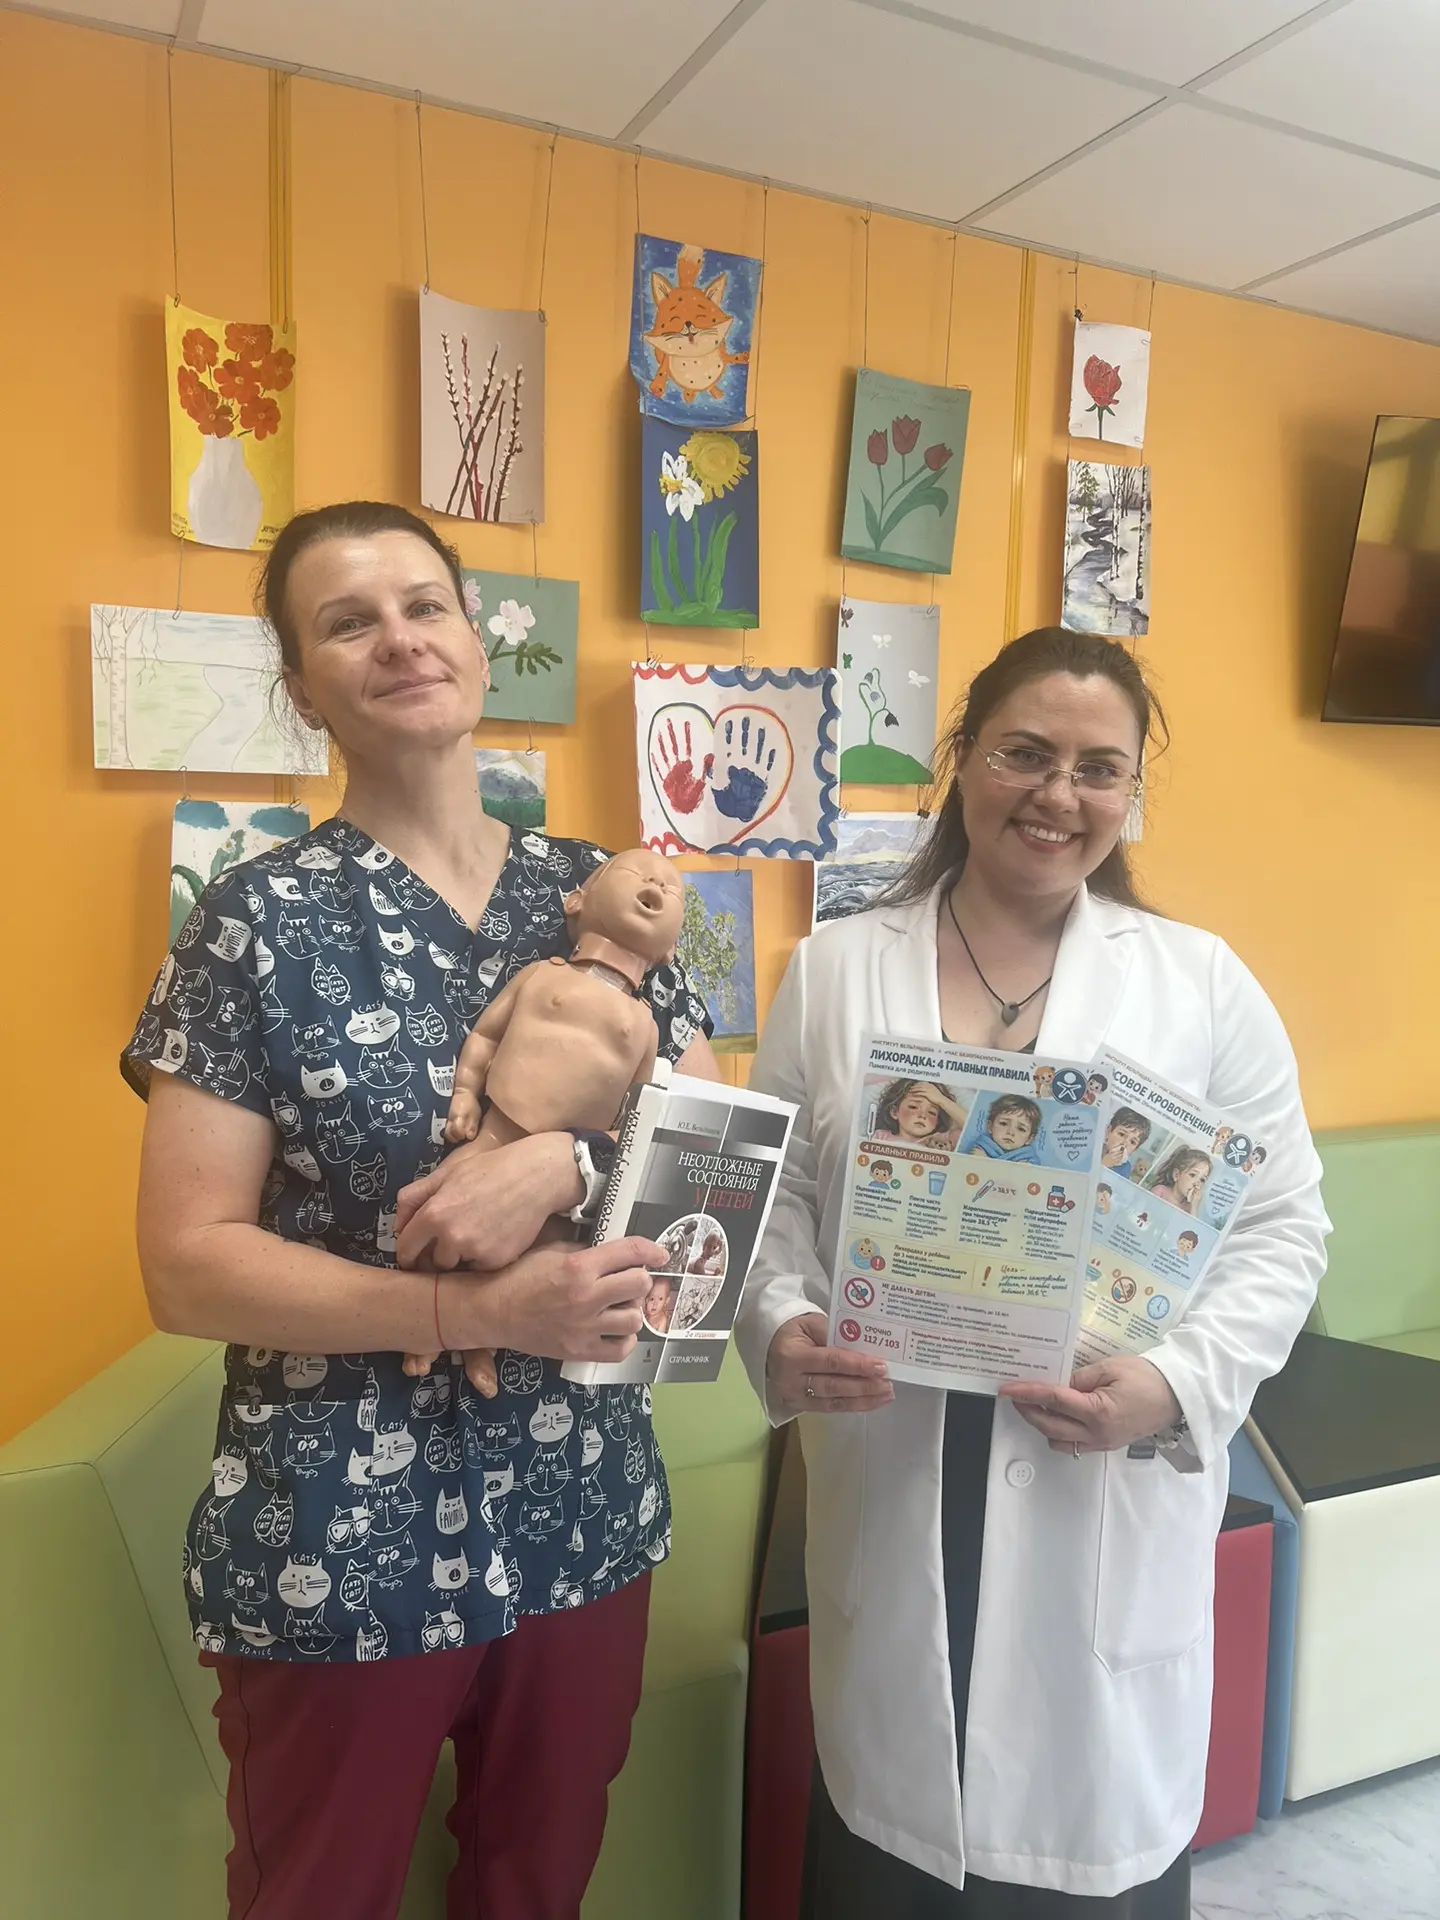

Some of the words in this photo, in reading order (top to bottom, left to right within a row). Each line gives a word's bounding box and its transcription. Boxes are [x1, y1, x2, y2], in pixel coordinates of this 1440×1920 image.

[223, 922, 249, 962] FAVORITE
[357, 1001, 381, 1014] CATS
[869, 1061, 894, 1071] Памятка
[907, 1067, 940, 1078] родителей
[870, 1047, 935, 1069] ЛИХОРАДКА:
[936, 1058, 943, 1068] 4
[945, 1059, 988, 1076] ГЛАВНЫХ
[988, 1065, 1030, 1082] ПРАВИЛА
[1111, 1070, 1149, 1096] СОВОЕ
[1145, 1090, 1217, 1136] КРОВОТЕЧЕНИЕ
[870, 1144, 908, 1156] ГЛАВНЫХ
[908, 1151, 945, 1163] ПРАВИЛА
[677, 1151, 764, 1177] НЕОТЛОЖНЫЕ
[687, 1169, 759, 1191] СОСТОЯНИЯ
[693, 1187, 704, 1208] У
[705, 1189, 755, 1210] ДЕТЕЙ
[890, 1284, 914, 1293] ДАВАТЬ
[864, 1325, 891, 1336] СРОЧНО
[863, 1334, 877, 1344] 112
[884, 1339, 899, 1349] 103
[669, 1355, 710, 1364] СПРАВОЧНИК
[545, 1391, 564, 1404] CATS
[380, 1421, 404, 1434] CATS
[225, 1444, 246, 1458] CATS
[293, 1553, 317, 1564] CATS
